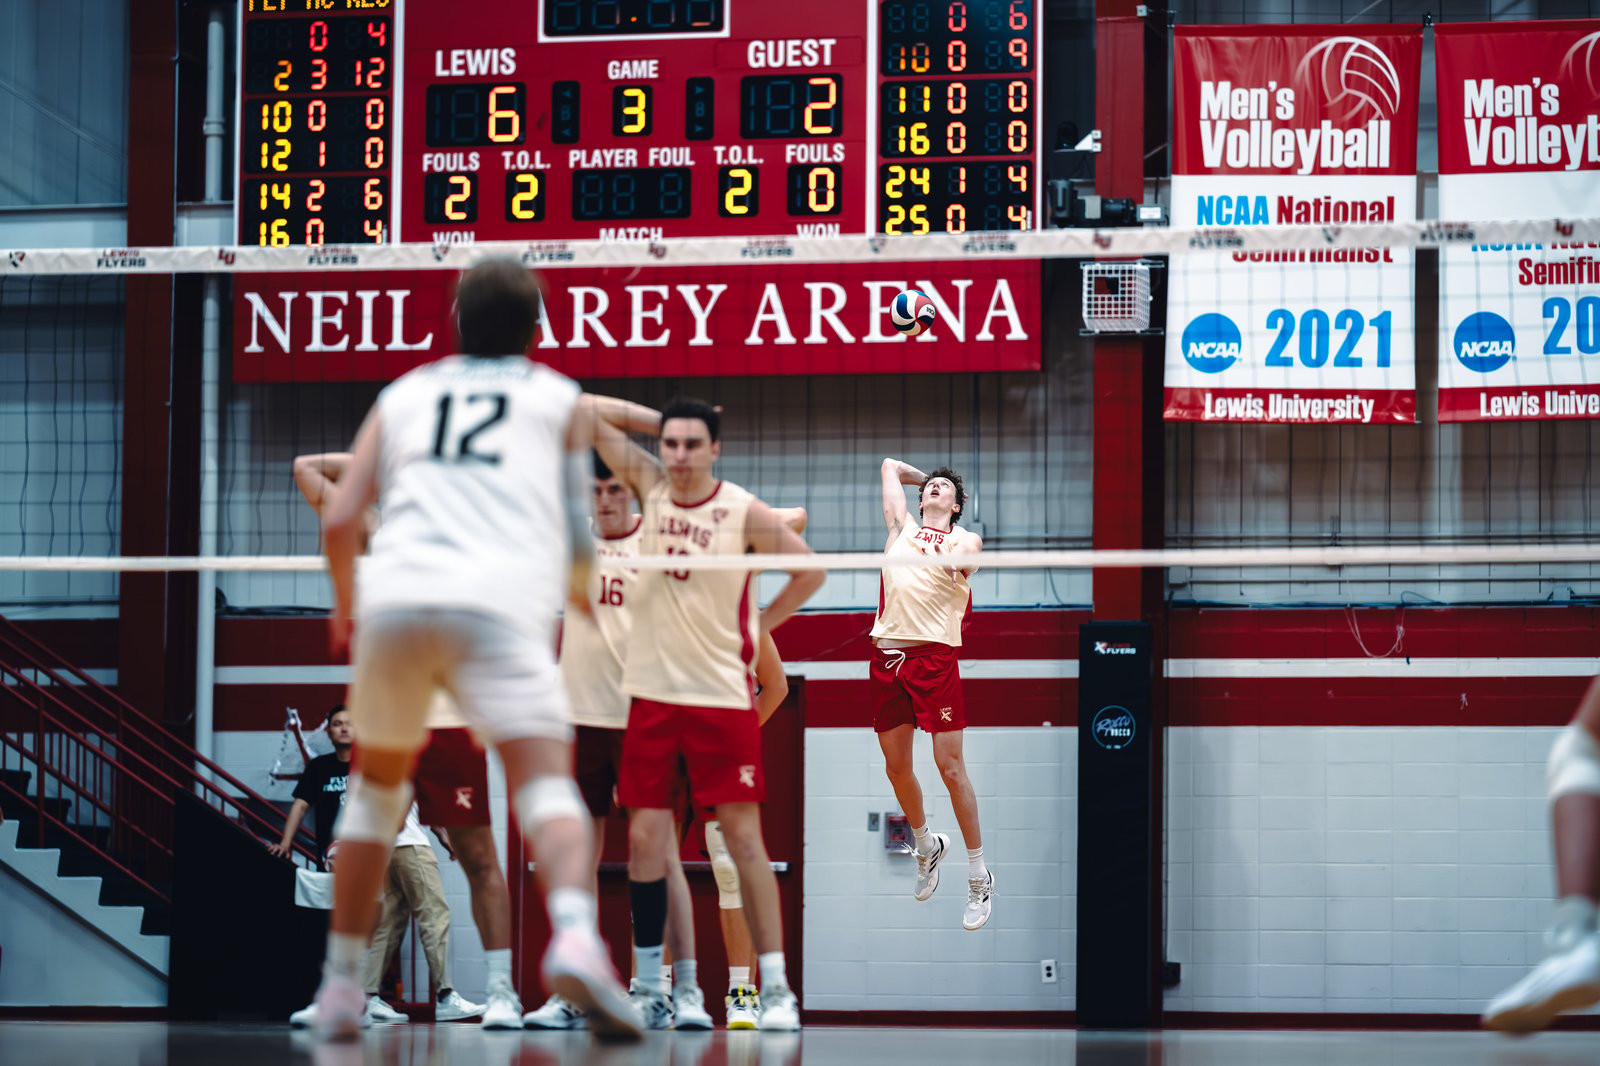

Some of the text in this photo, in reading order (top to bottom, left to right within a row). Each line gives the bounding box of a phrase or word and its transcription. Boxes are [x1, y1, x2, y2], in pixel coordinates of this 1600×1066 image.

[948, 1, 1027, 32] 0 6
[310, 21, 386, 51] 0 4
[435, 48, 516, 76] LEWIS
[747, 38, 837, 68] GUEST
[947, 40, 966, 71] 0
[1008, 38, 1028, 67] 9
[274, 57, 385, 91] 2 3 12
[607, 60, 659, 81] GAME
[488, 86, 520, 142] 6
[622, 88, 647, 135] 3
[804, 78, 837, 134] 2
[899, 81, 1028, 114] 11 0 0
[1200, 81, 1295, 121] Men's
[1464, 77, 1560, 118] Men's
[262, 98, 384, 133] 10 0 0
[261, 137, 384, 171] 12 1 0
[785, 143, 845, 163] FOULS
[898, 120, 1027, 155] 16 0 0
[1199, 119, 1391, 175] Volleyball
[1464, 115, 1600, 171] Volleyb
[422, 152, 480, 172] FOULS
[502, 151, 551, 170] T.O.L.
[569, 147, 695, 168] PLAYER FOUL
[714, 145, 764, 165] T.O.L.
[260, 178, 383, 212] 14 2 6
[445, 176, 471, 220] 2
[512, 174, 539, 219] 2
[725, 169, 752, 214] 2
[808, 167, 835, 212] 0
[885, 165, 1027, 198] 24 1 4
[885, 204, 930, 236] 25
[947, 203, 966, 235] 0
[1008, 205, 1027, 231] 4
[1197, 195, 1395, 226] NCAA National
[259, 218, 383, 248] 16 0 4
[432, 231, 476, 246] WON
[599, 226, 664, 244] MATCH
[796, 223, 841, 240] WON
[244, 290, 434, 354] NEIL
[744, 278, 1029, 345] ARENA
[1542, 296, 1600, 356] 20
[1187, 342, 1239, 359] NCAA
[1264, 309, 1392, 368] 2021
[1460, 340, 1513, 358] NCAA
[1204, 393, 1375, 423] Lewis University
[1480, 389, 1600, 417] Lewis Unive
[429, 391, 510, 466] 12
[598, 575, 624, 607] 16
